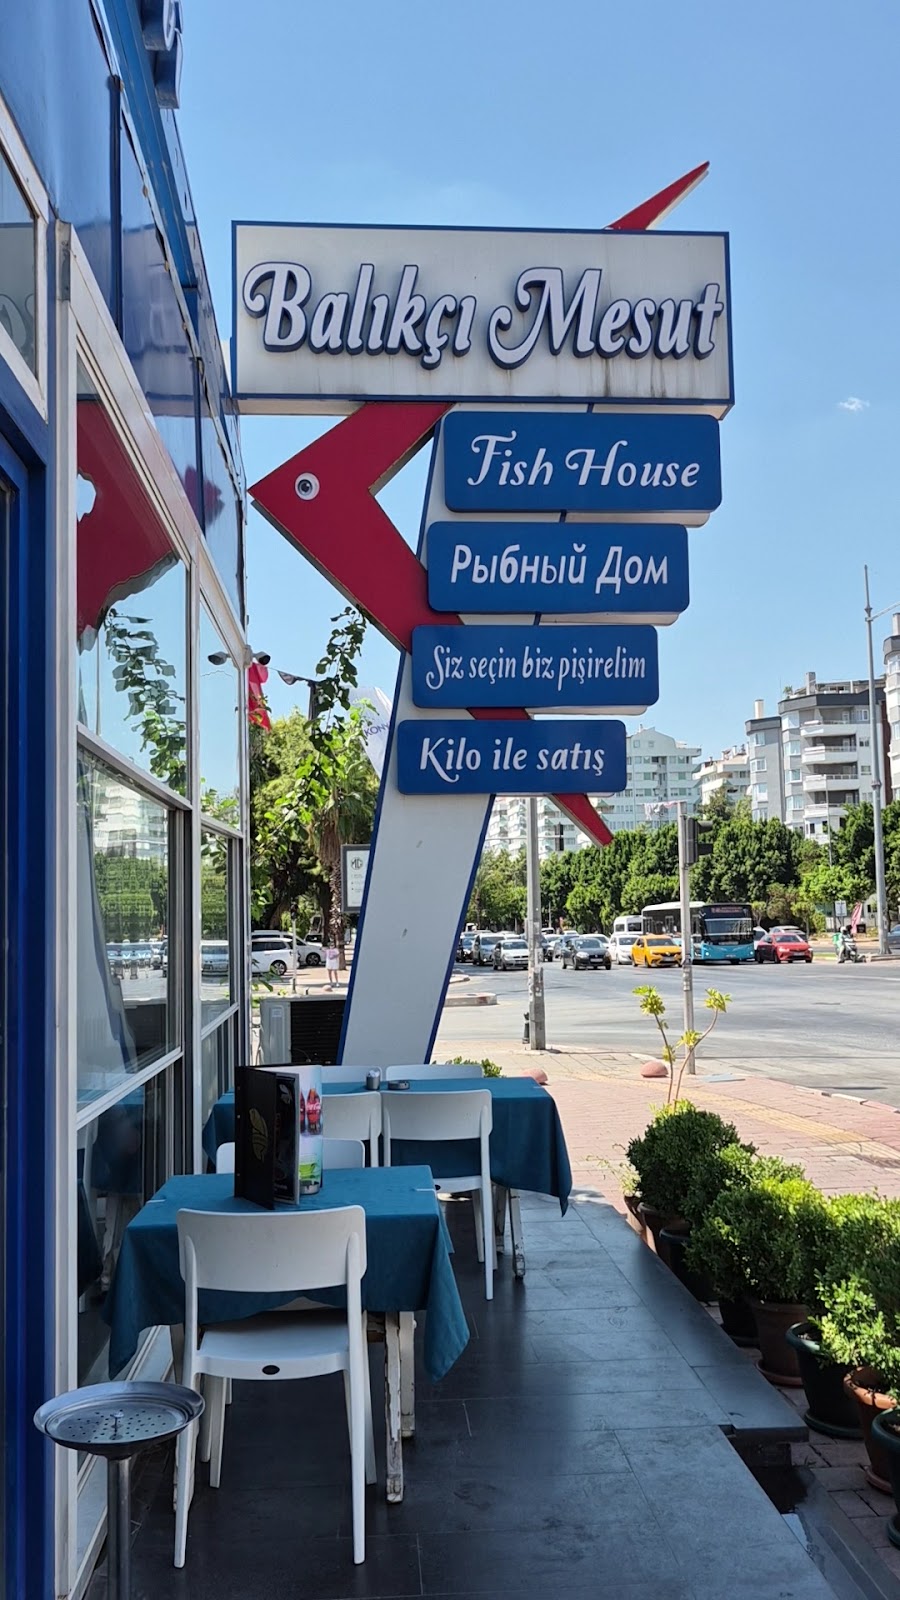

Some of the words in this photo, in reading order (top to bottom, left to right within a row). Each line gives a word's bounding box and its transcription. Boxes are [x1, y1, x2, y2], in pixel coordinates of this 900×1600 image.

[242, 261, 477, 370] Balıkçı
[487, 266, 724, 370] Mesut
[467, 430, 553, 487] Fish
[565, 440, 700, 487] House
[450, 542, 587, 584] Рыбный
[595, 546, 668, 594] Дом
[426, 644, 464, 691] Siz
[468, 647, 517, 684] seçin
[522, 646, 554, 679] biz
[558, 646, 646, 691] pişirelim
[419, 737, 481, 783] Kilo
[493, 737, 527, 770] ile
[536, 743, 605, 776] satış
